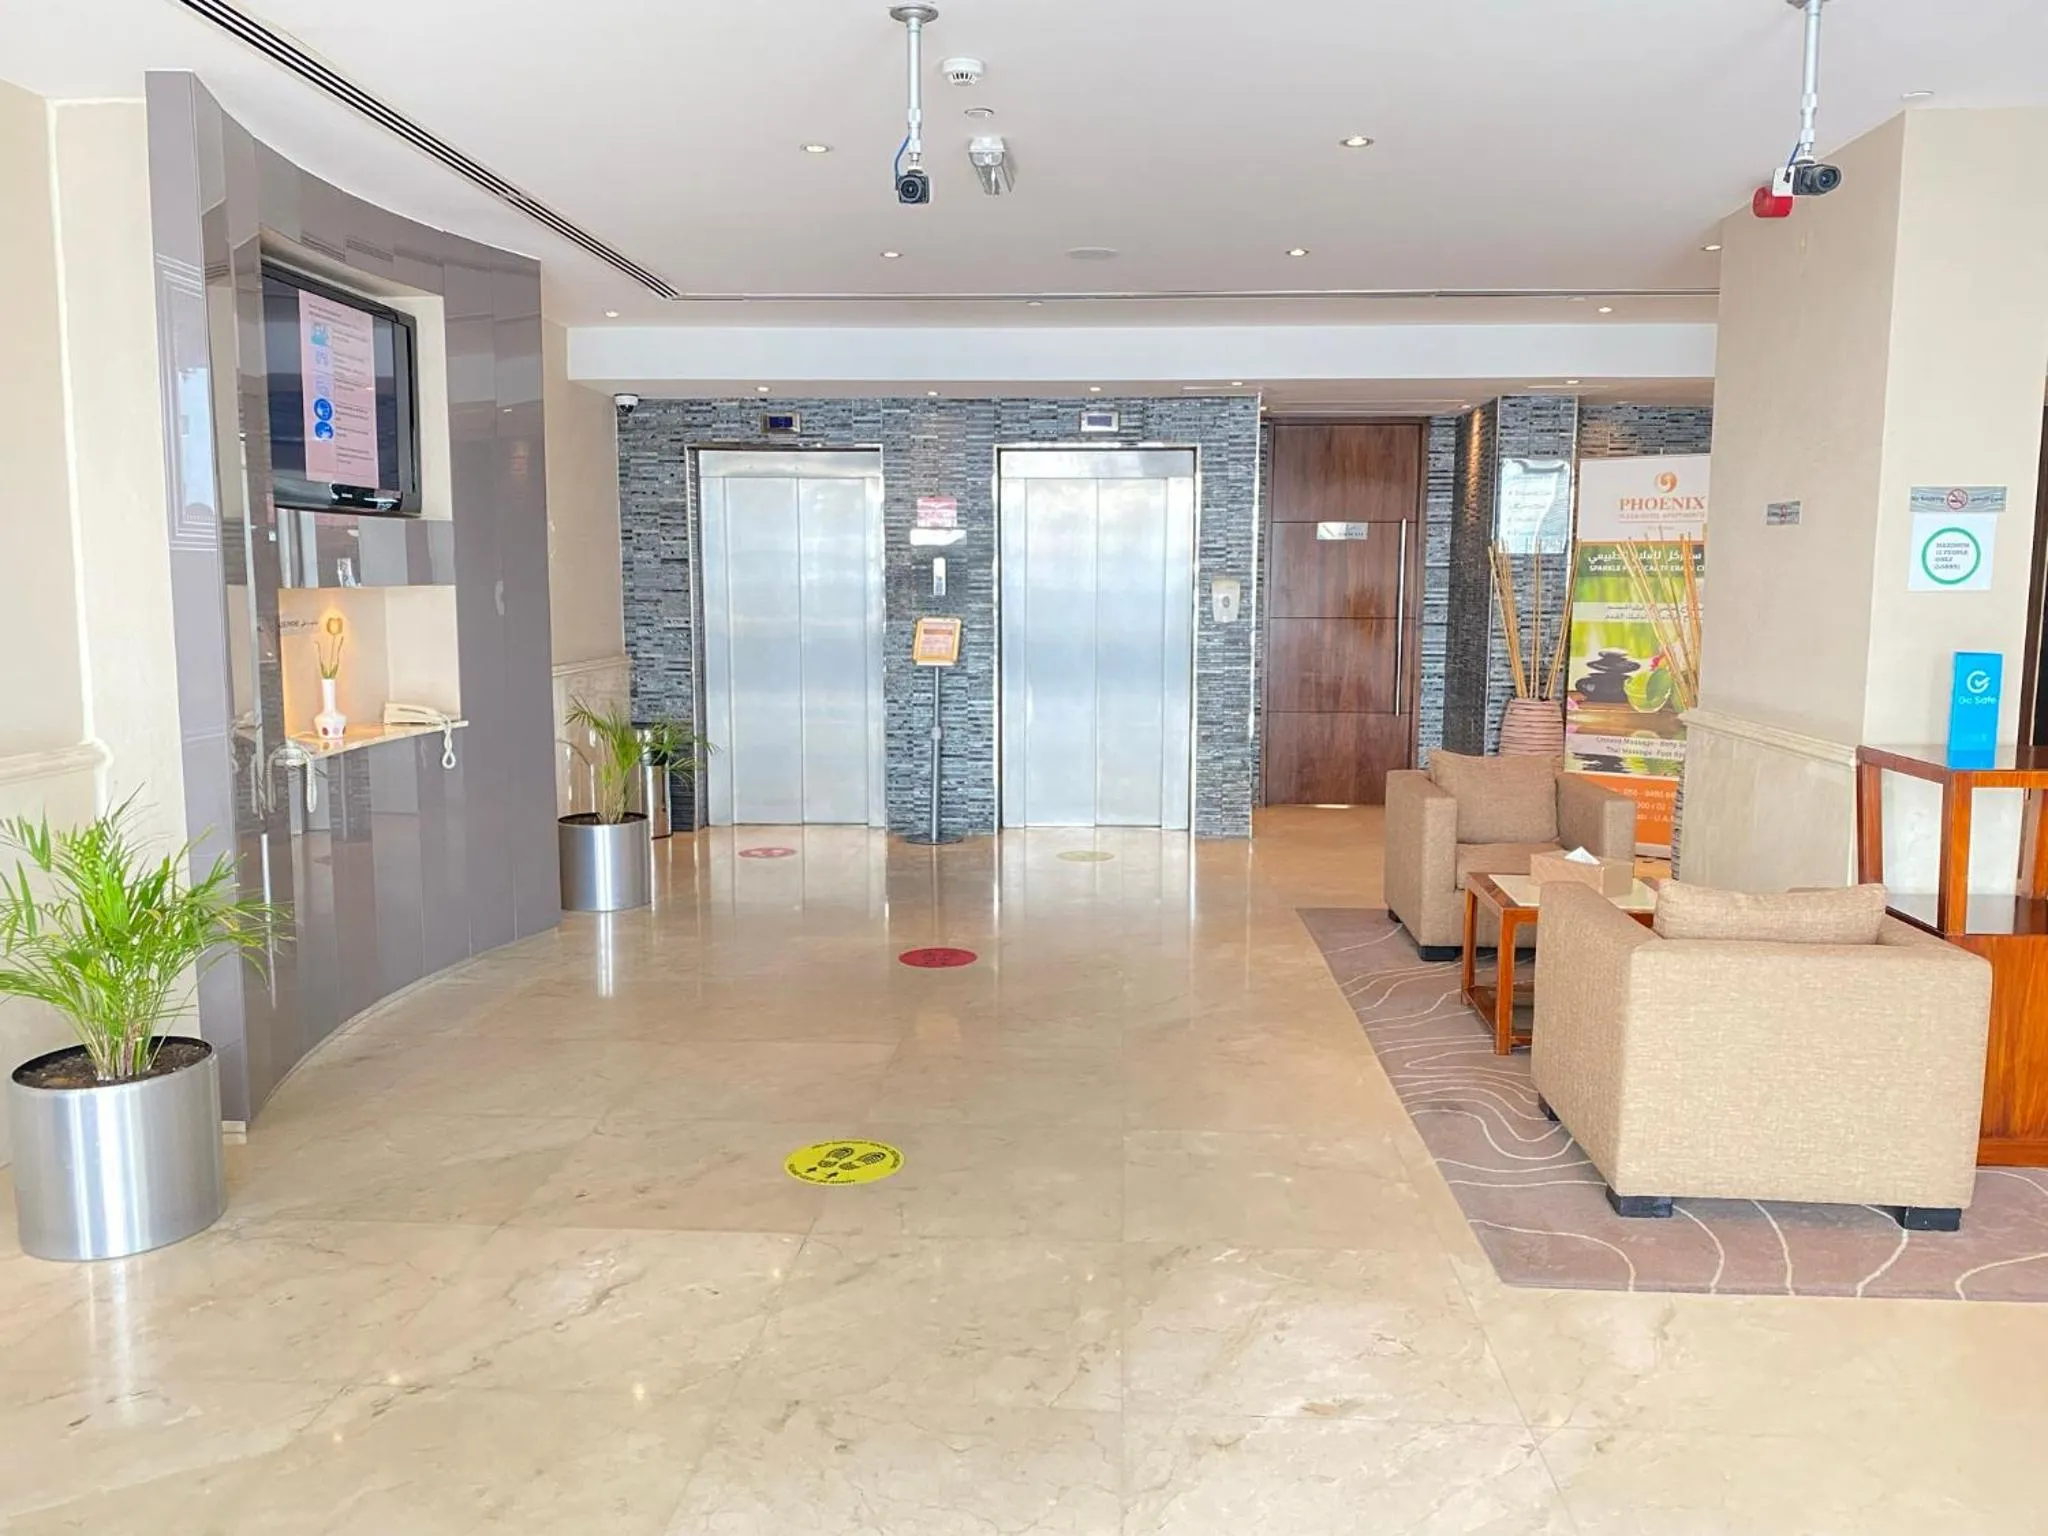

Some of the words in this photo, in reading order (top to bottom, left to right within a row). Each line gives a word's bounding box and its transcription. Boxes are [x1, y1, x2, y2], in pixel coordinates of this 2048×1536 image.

[1620, 496, 1705, 511] PHOENIX
[1974, 696, 1997, 705] Safe
[1623, 738, 1654, 747] Massage
[1622, 747, 1653, 757] Massage
